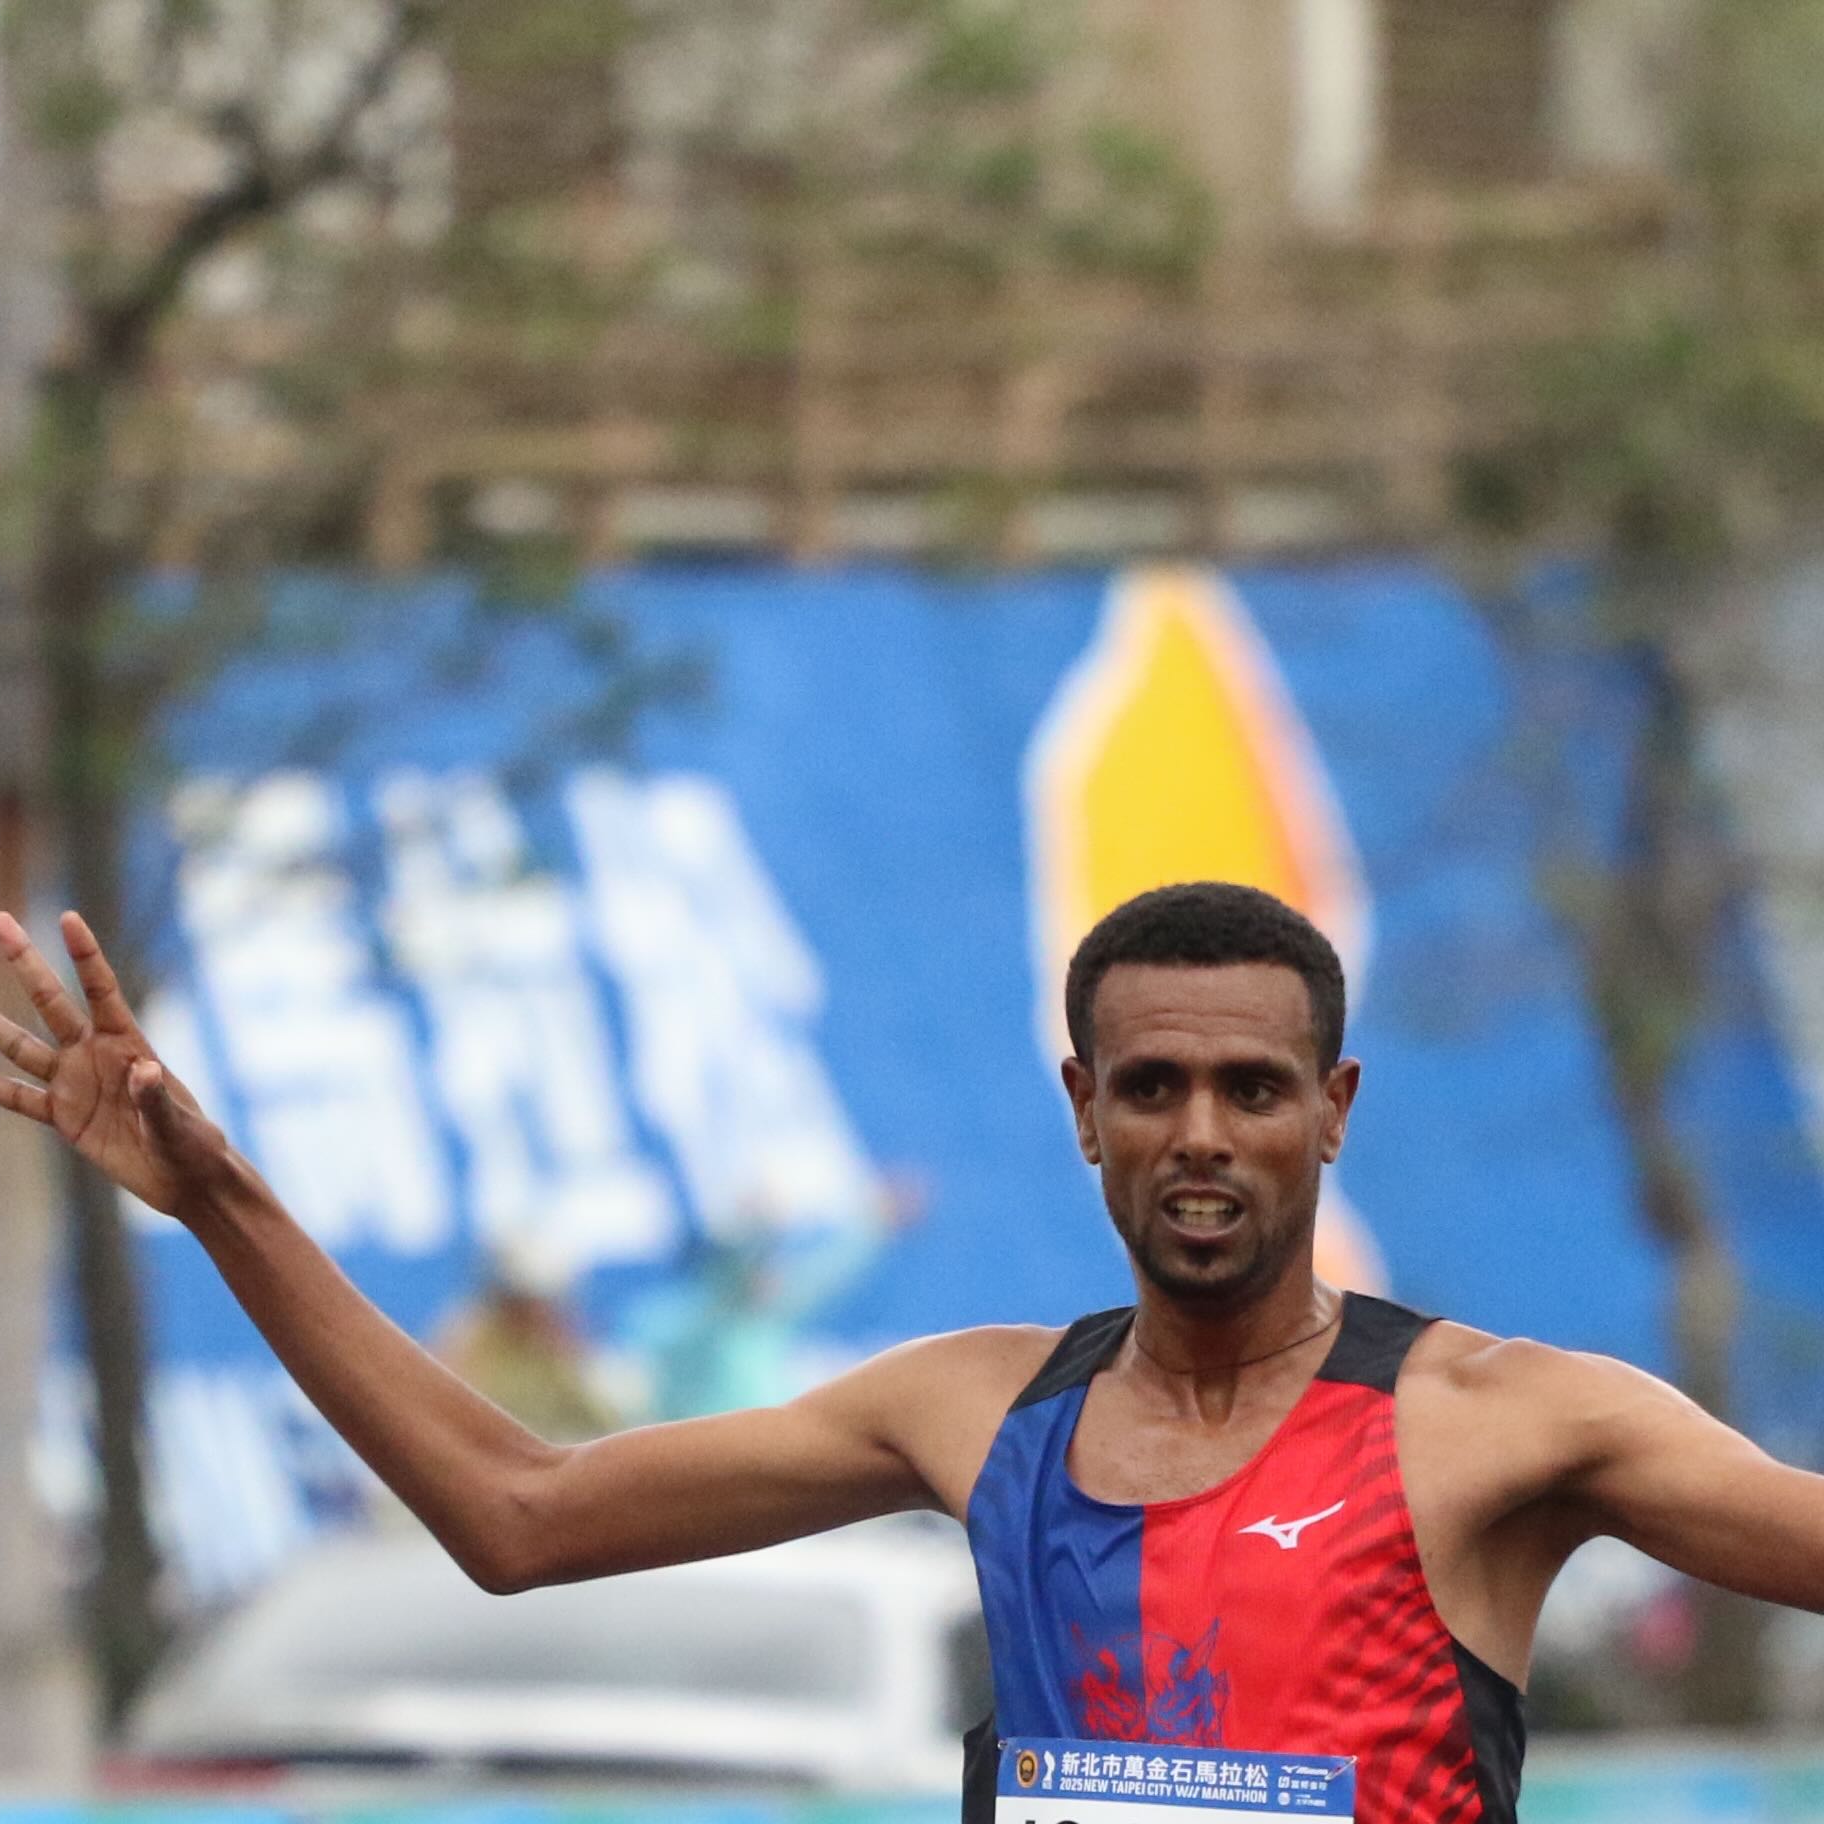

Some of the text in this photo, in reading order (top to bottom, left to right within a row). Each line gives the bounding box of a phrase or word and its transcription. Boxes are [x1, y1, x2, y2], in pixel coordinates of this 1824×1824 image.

[1061, 1751, 1269, 1789] 新北市萬金石馬拉松
[1060, 1777, 1083, 1791] 2025
[1084, 1779, 1108, 1793] NEW
[1111, 1780, 1146, 1796] TAIPEI
[1147, 1783, 1173, 1797] CITY
[1202, 1787, 1267, 1804] MARATHON
